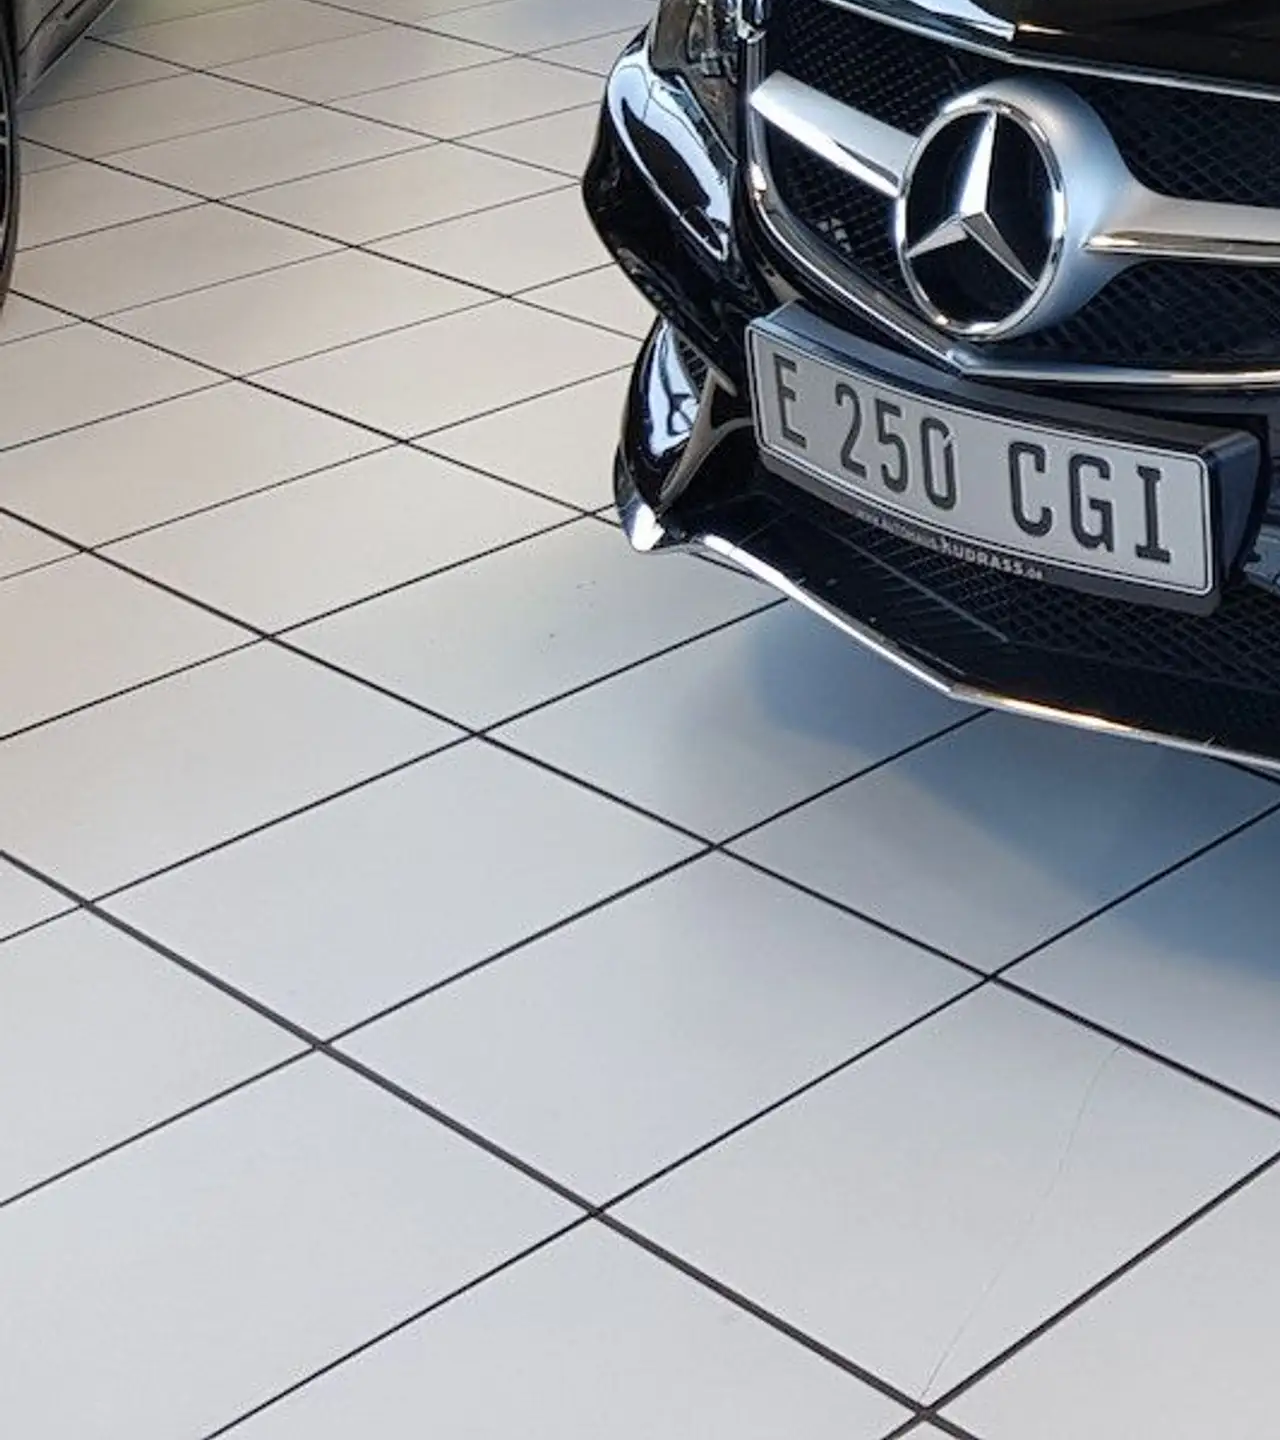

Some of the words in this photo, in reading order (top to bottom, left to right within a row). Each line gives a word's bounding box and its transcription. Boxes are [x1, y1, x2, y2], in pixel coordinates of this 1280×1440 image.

[772, 353, 808, 450] E
[835, 382, 959, 513] 250
[1008, 439, 1173, 565] CGI
